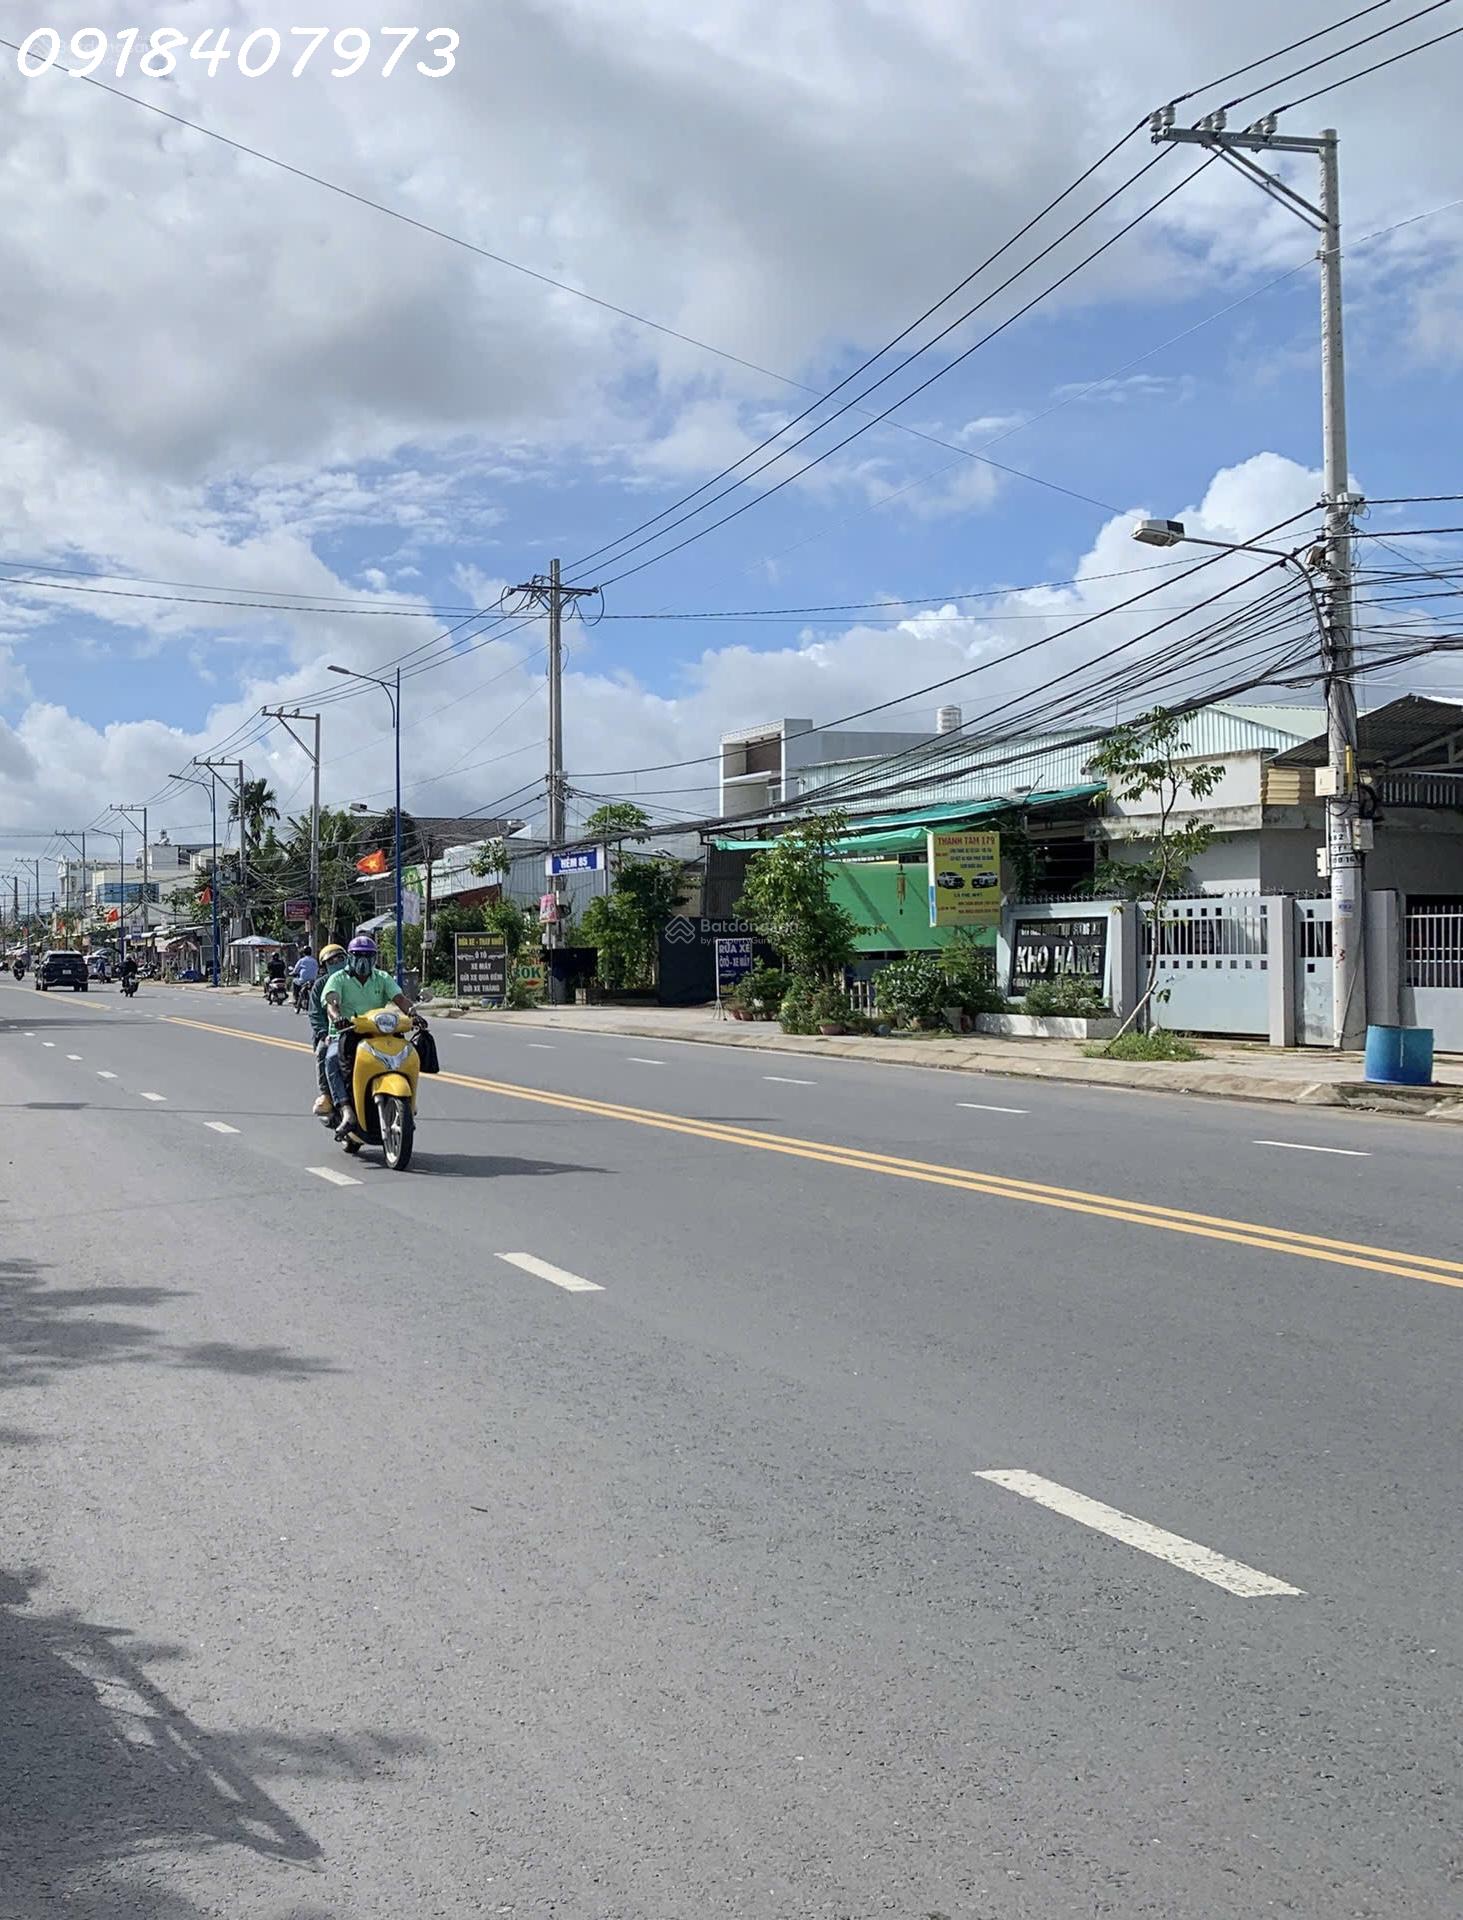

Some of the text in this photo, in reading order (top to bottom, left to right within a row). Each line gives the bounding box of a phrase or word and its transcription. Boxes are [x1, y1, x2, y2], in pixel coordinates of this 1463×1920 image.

[719, 941, 751, 953] RỬA XE
[1016, 939, 1101, 974] KHO HÀNG
